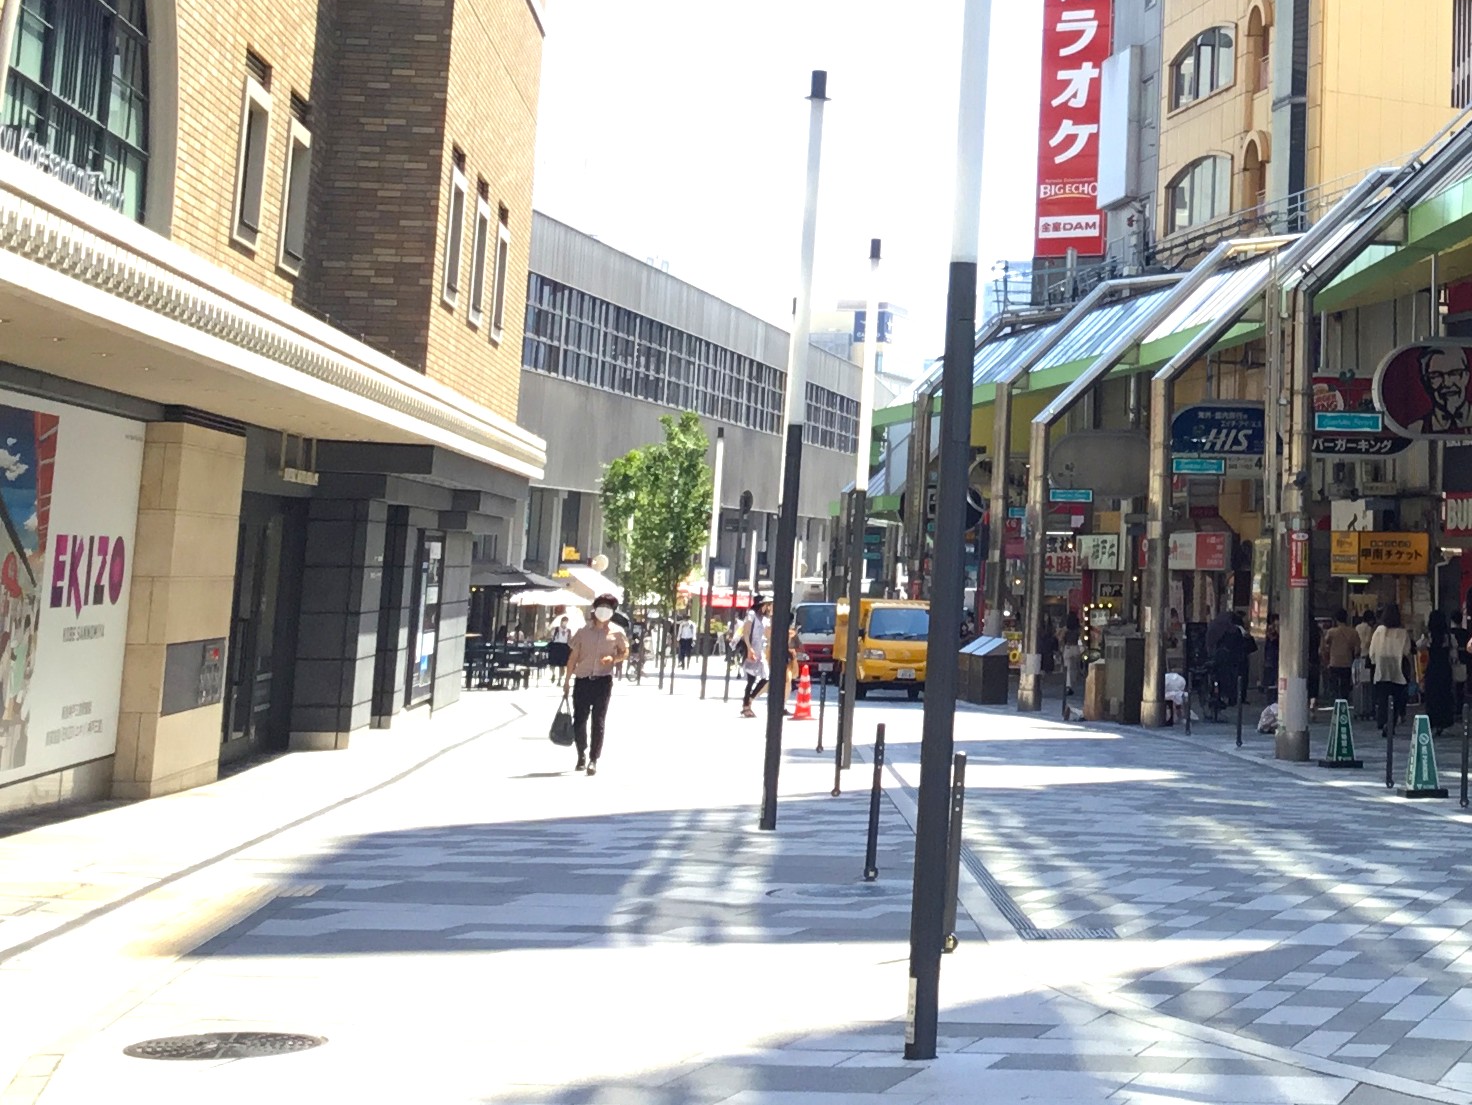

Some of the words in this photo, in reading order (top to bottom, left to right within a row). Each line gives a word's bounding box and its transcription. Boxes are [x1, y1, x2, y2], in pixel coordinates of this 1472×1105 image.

[1040, 184, 1064, 199] BIG
[1065, 182, 1098, 196] ECHO
[1203, 429, 1253, 451] HIS
[1312, 438, 1394, 454] バーガーキング
[1361, 548, 1423, 562] 甲南チケット
[50, 534, 126, 619] EKIZO
